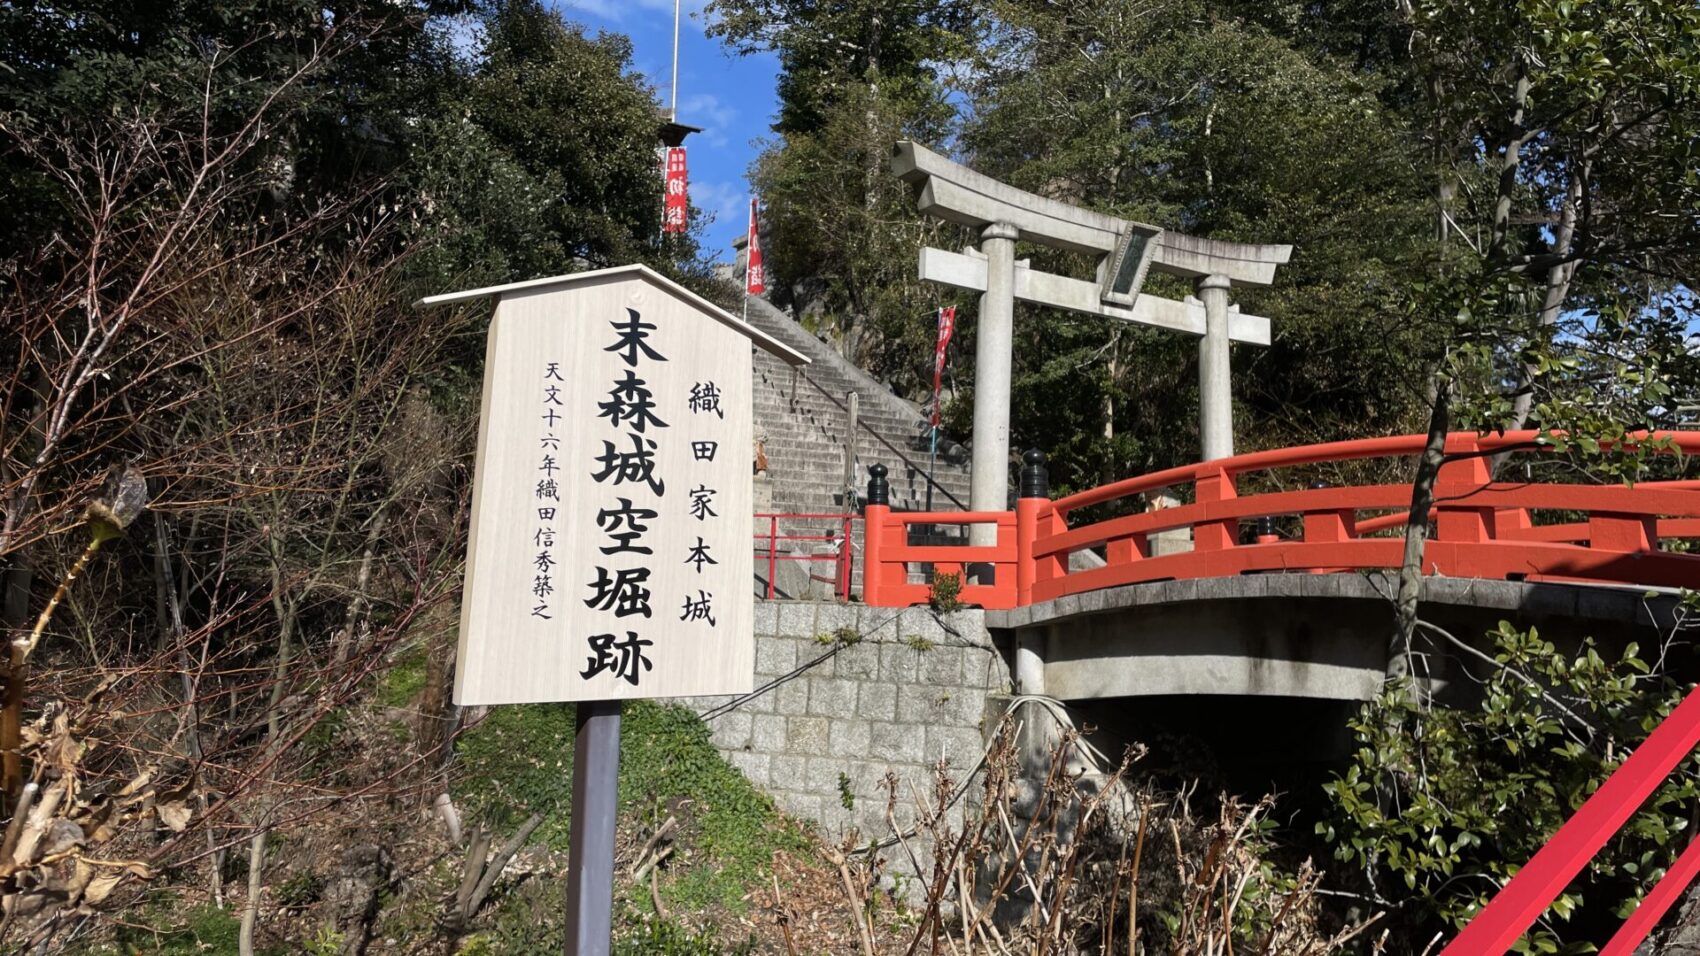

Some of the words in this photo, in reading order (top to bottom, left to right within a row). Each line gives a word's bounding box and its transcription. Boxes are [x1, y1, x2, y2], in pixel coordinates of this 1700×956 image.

[532, 363, 563, 620] 天文十六年織田信秀築之
[580, 308, 669, 685] 末森城空堀跡
[680, 382, 723, 626] 織田家本城
